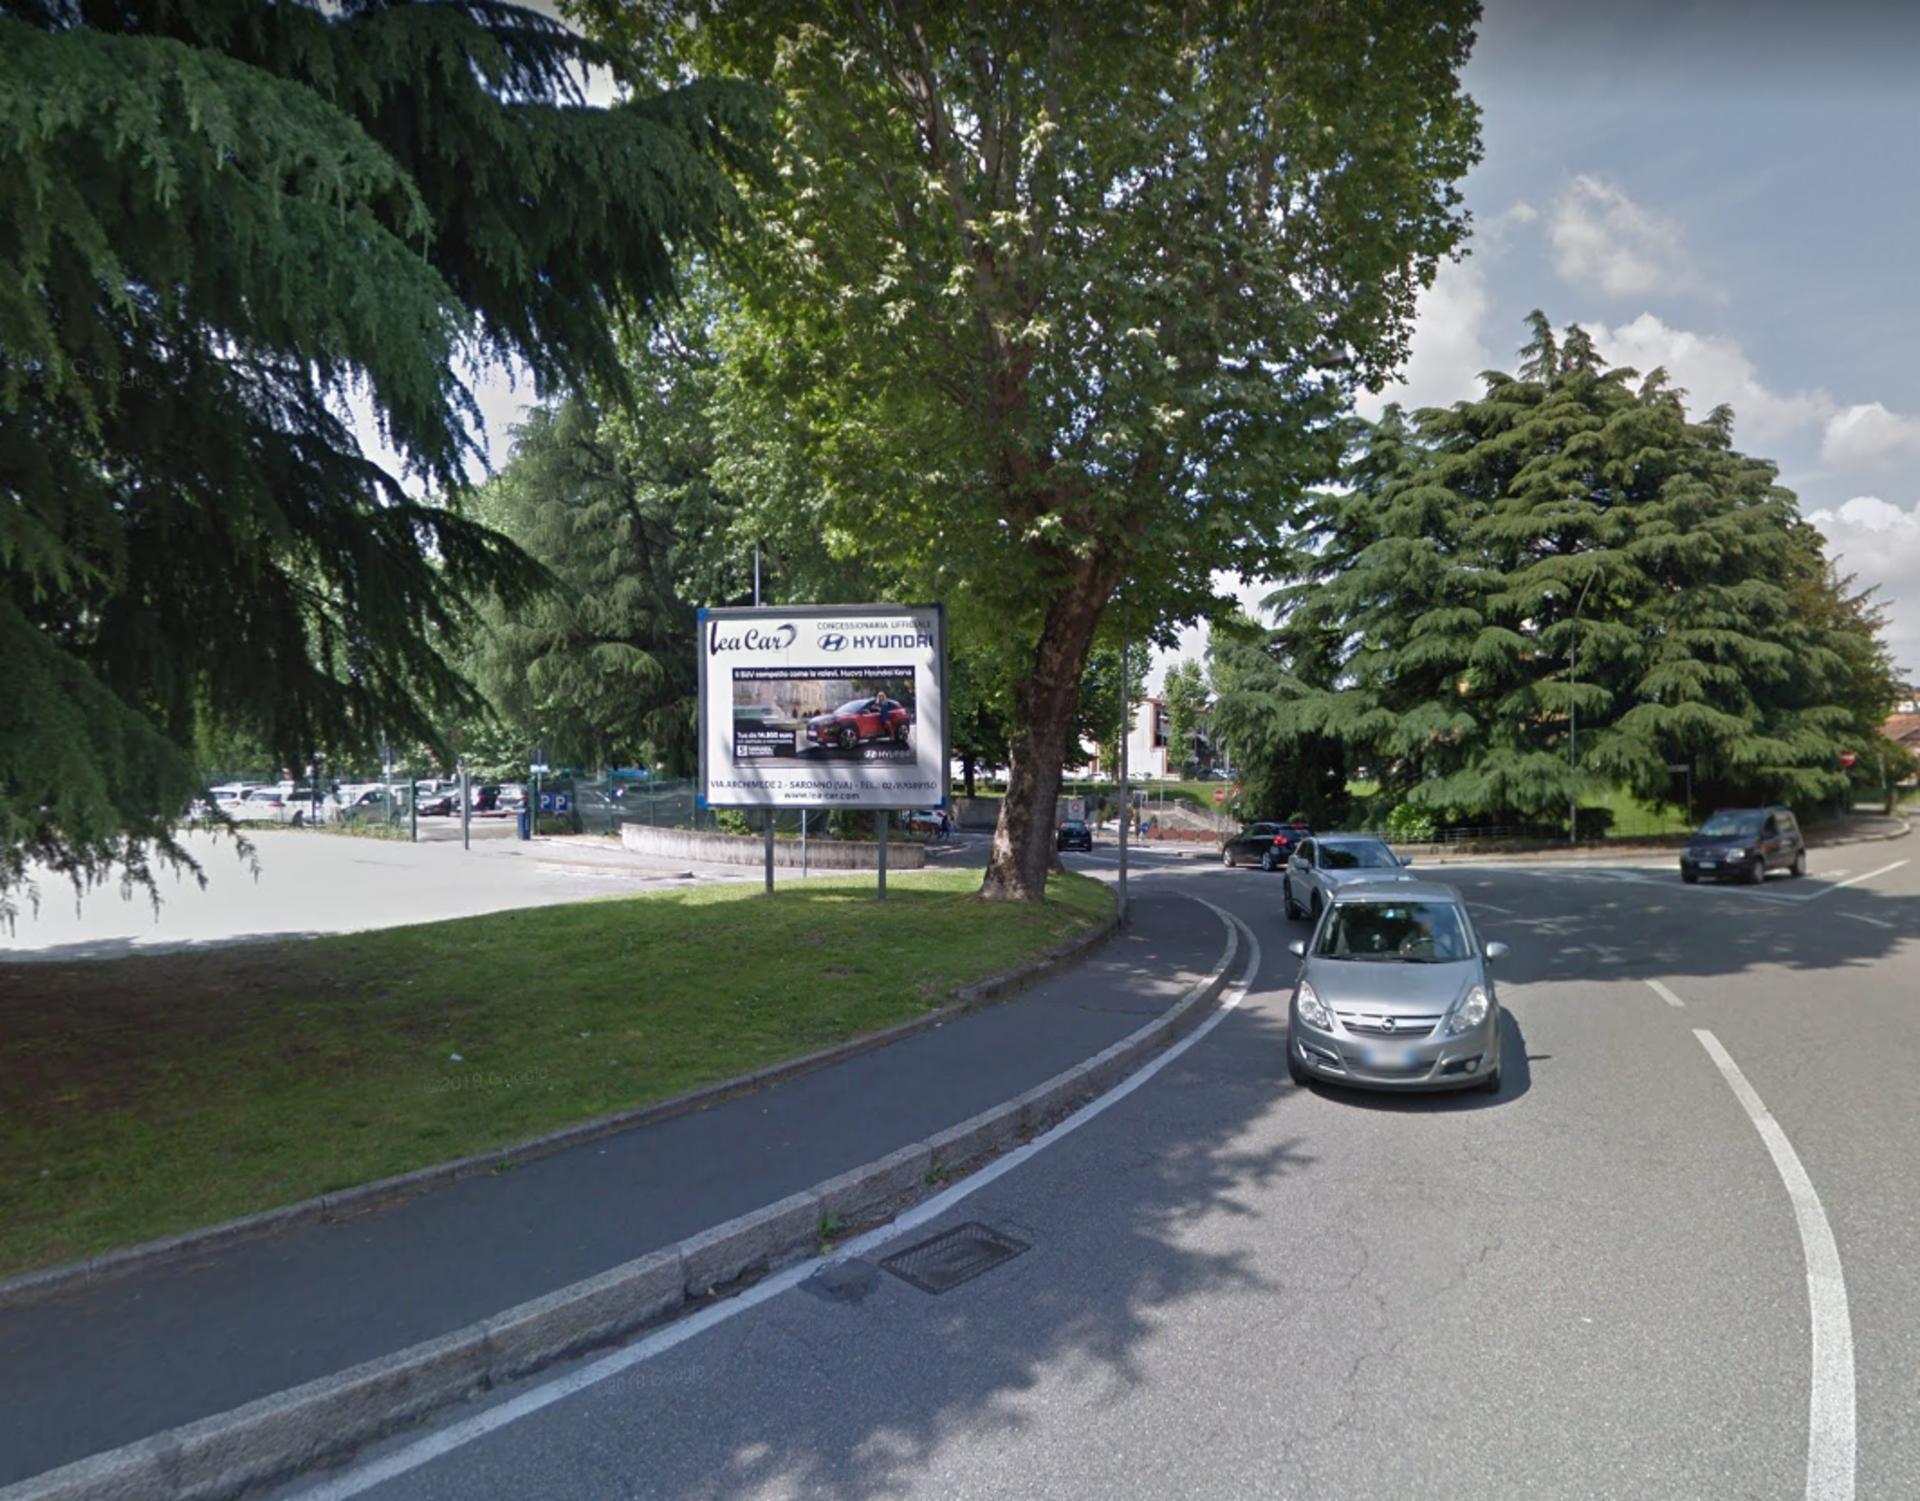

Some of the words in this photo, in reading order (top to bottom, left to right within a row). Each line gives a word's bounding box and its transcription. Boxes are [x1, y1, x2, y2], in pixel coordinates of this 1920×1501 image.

[817, 621, 889, 631] CONCESSIONARIA
[891, 620, 931, 630] UFFICIALE
[744, 628, 783, 651] Car
[853, 633, 934, 649] HYUNDAI
[710, 780, 724, 789] VIA
[725, 780, 776, 789] ARCHIMEDE
[789, 780, 833, 790] SARONNO
[834, 780, 853, 790] (VA)
